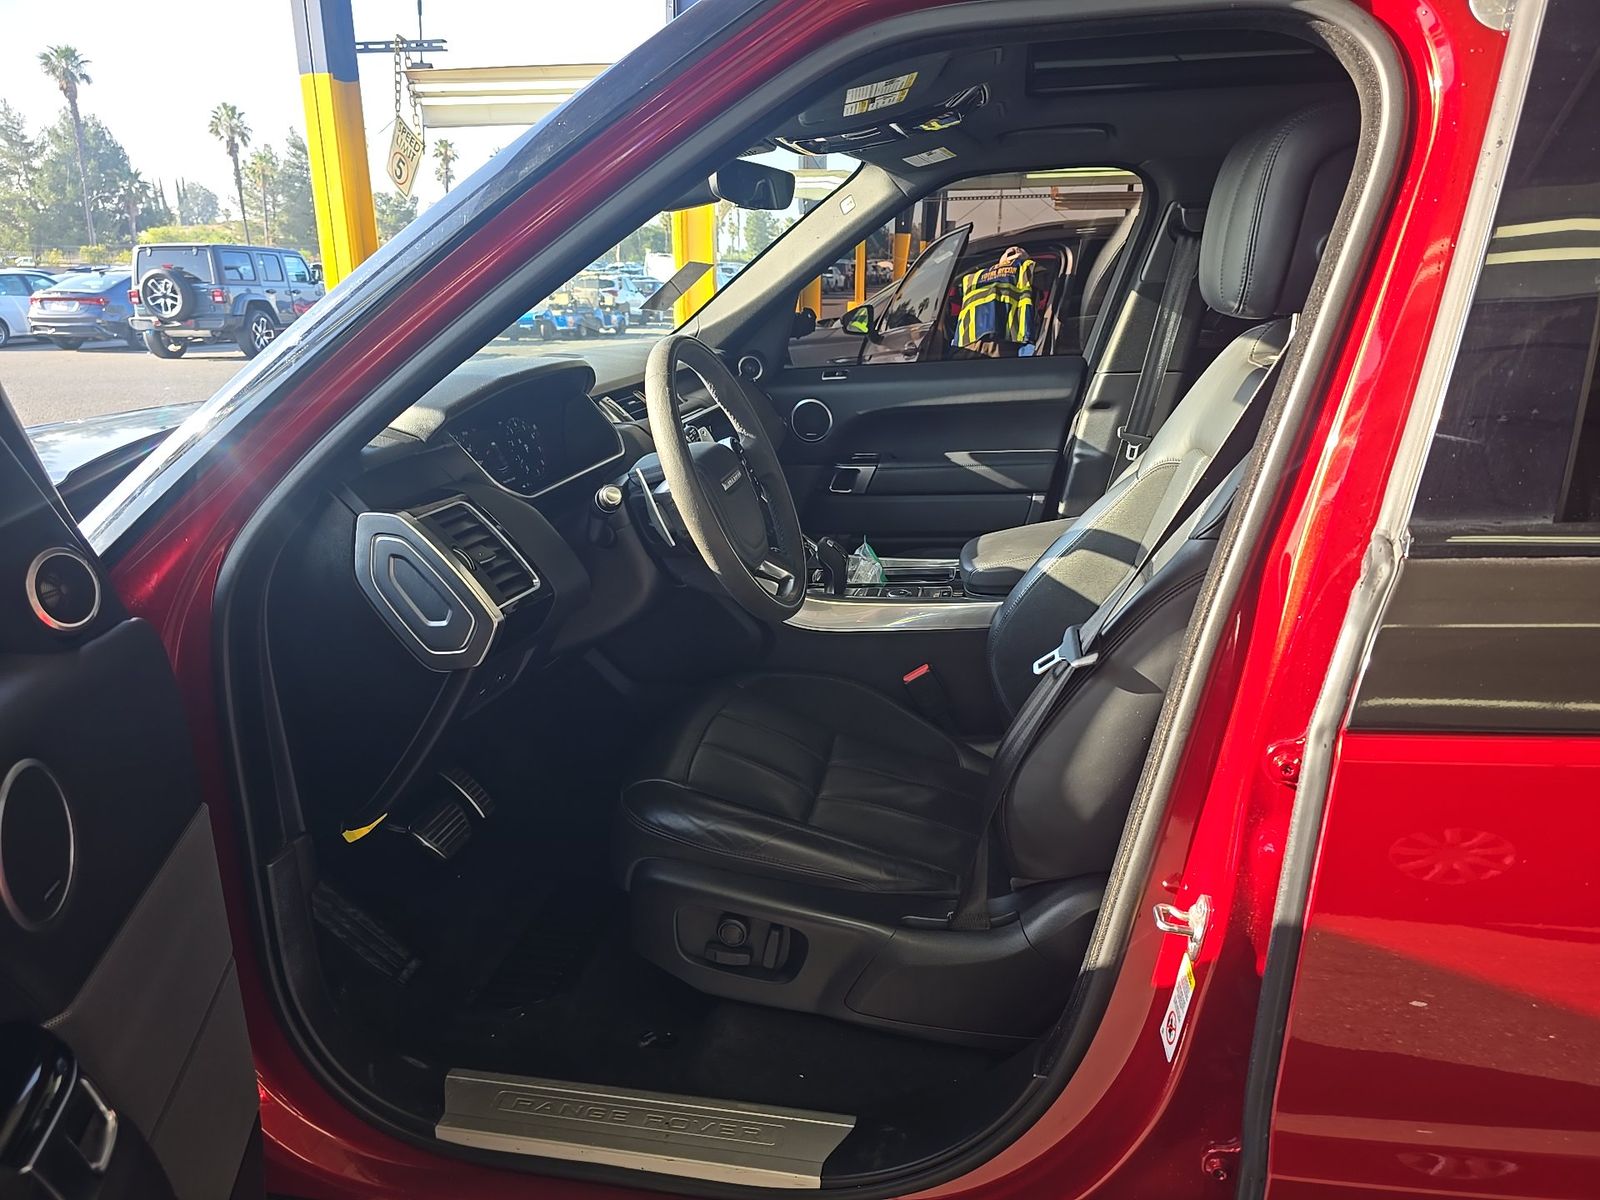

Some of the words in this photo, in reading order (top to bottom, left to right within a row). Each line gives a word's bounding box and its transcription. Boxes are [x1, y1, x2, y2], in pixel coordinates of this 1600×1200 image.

[396, 134, 416, 162] LIMIT
[398, 121, 421, 152] SPEED
[394, 157, 406, 180] 5
[511, 1097, 630, 1122] RANGE
[643, 1114, 763, 1137] ROVER
